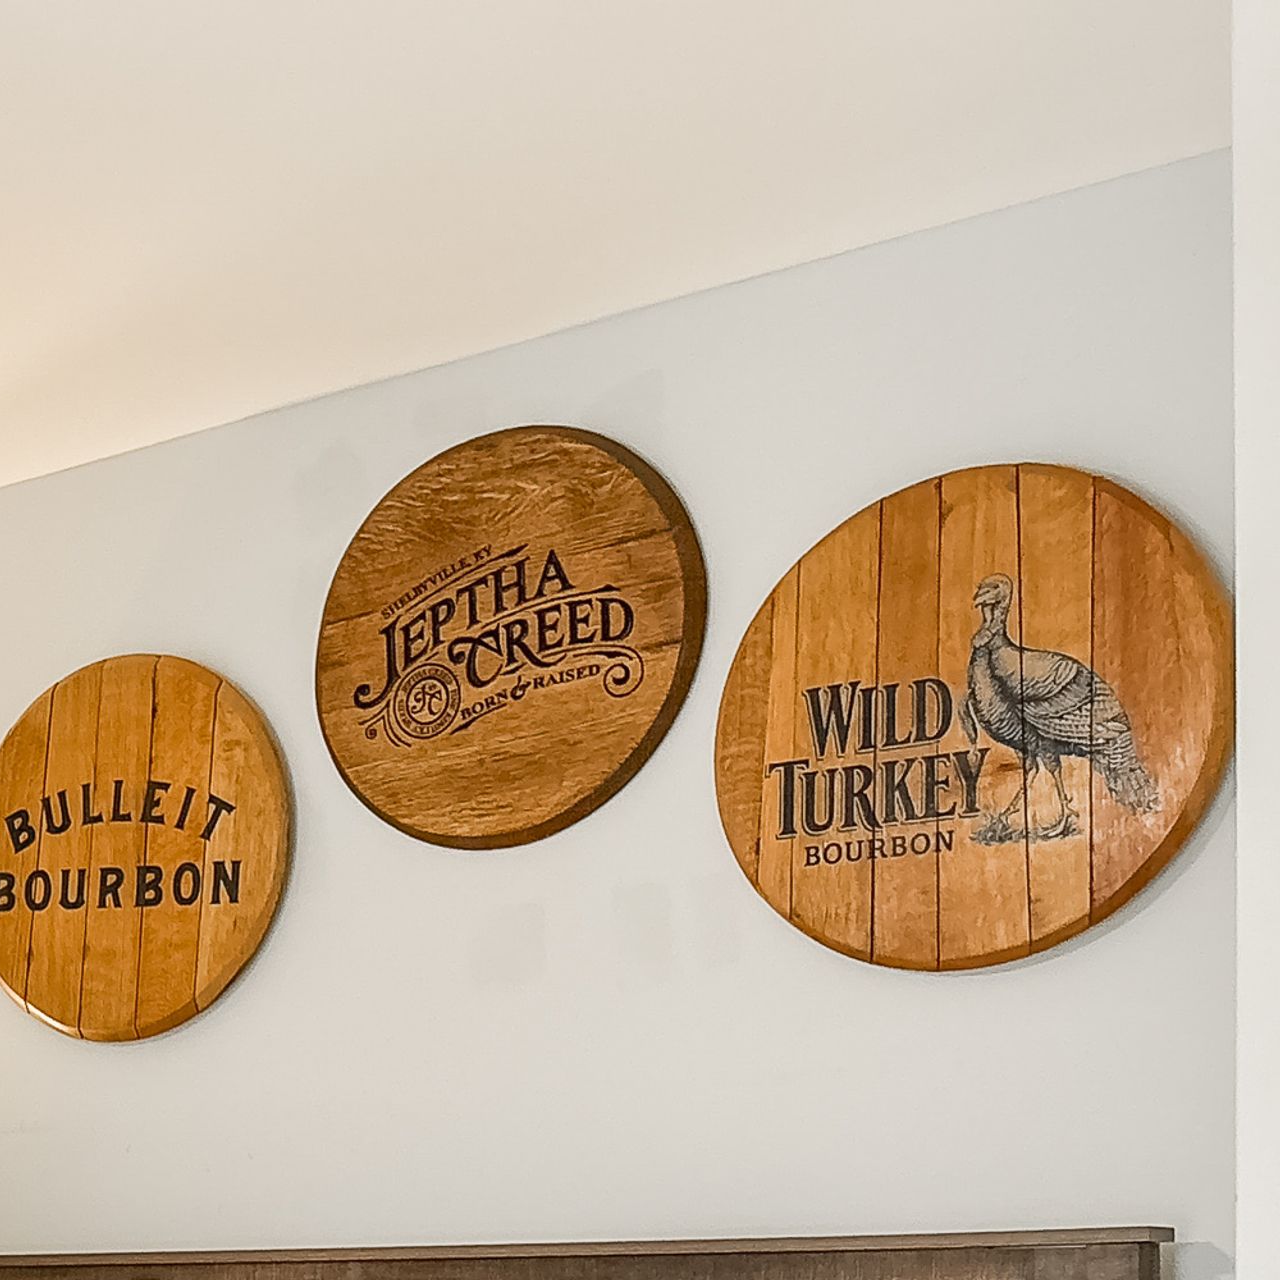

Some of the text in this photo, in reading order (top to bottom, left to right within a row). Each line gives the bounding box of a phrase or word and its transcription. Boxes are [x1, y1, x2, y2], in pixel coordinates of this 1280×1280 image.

[473, 543, 493, 563] KY
[353, 549, 577, 709] JEPTHA
[448, 597, 635, 688] CREED
[460, 663, 601, 721] BORN & RAISED
[801, 676, 953, 762] WILD
[3, 778, 237, 855] BULLEIT
[764, 747, 991, 841] TURKEY
[803, 829, 955, 868] BOURBON
